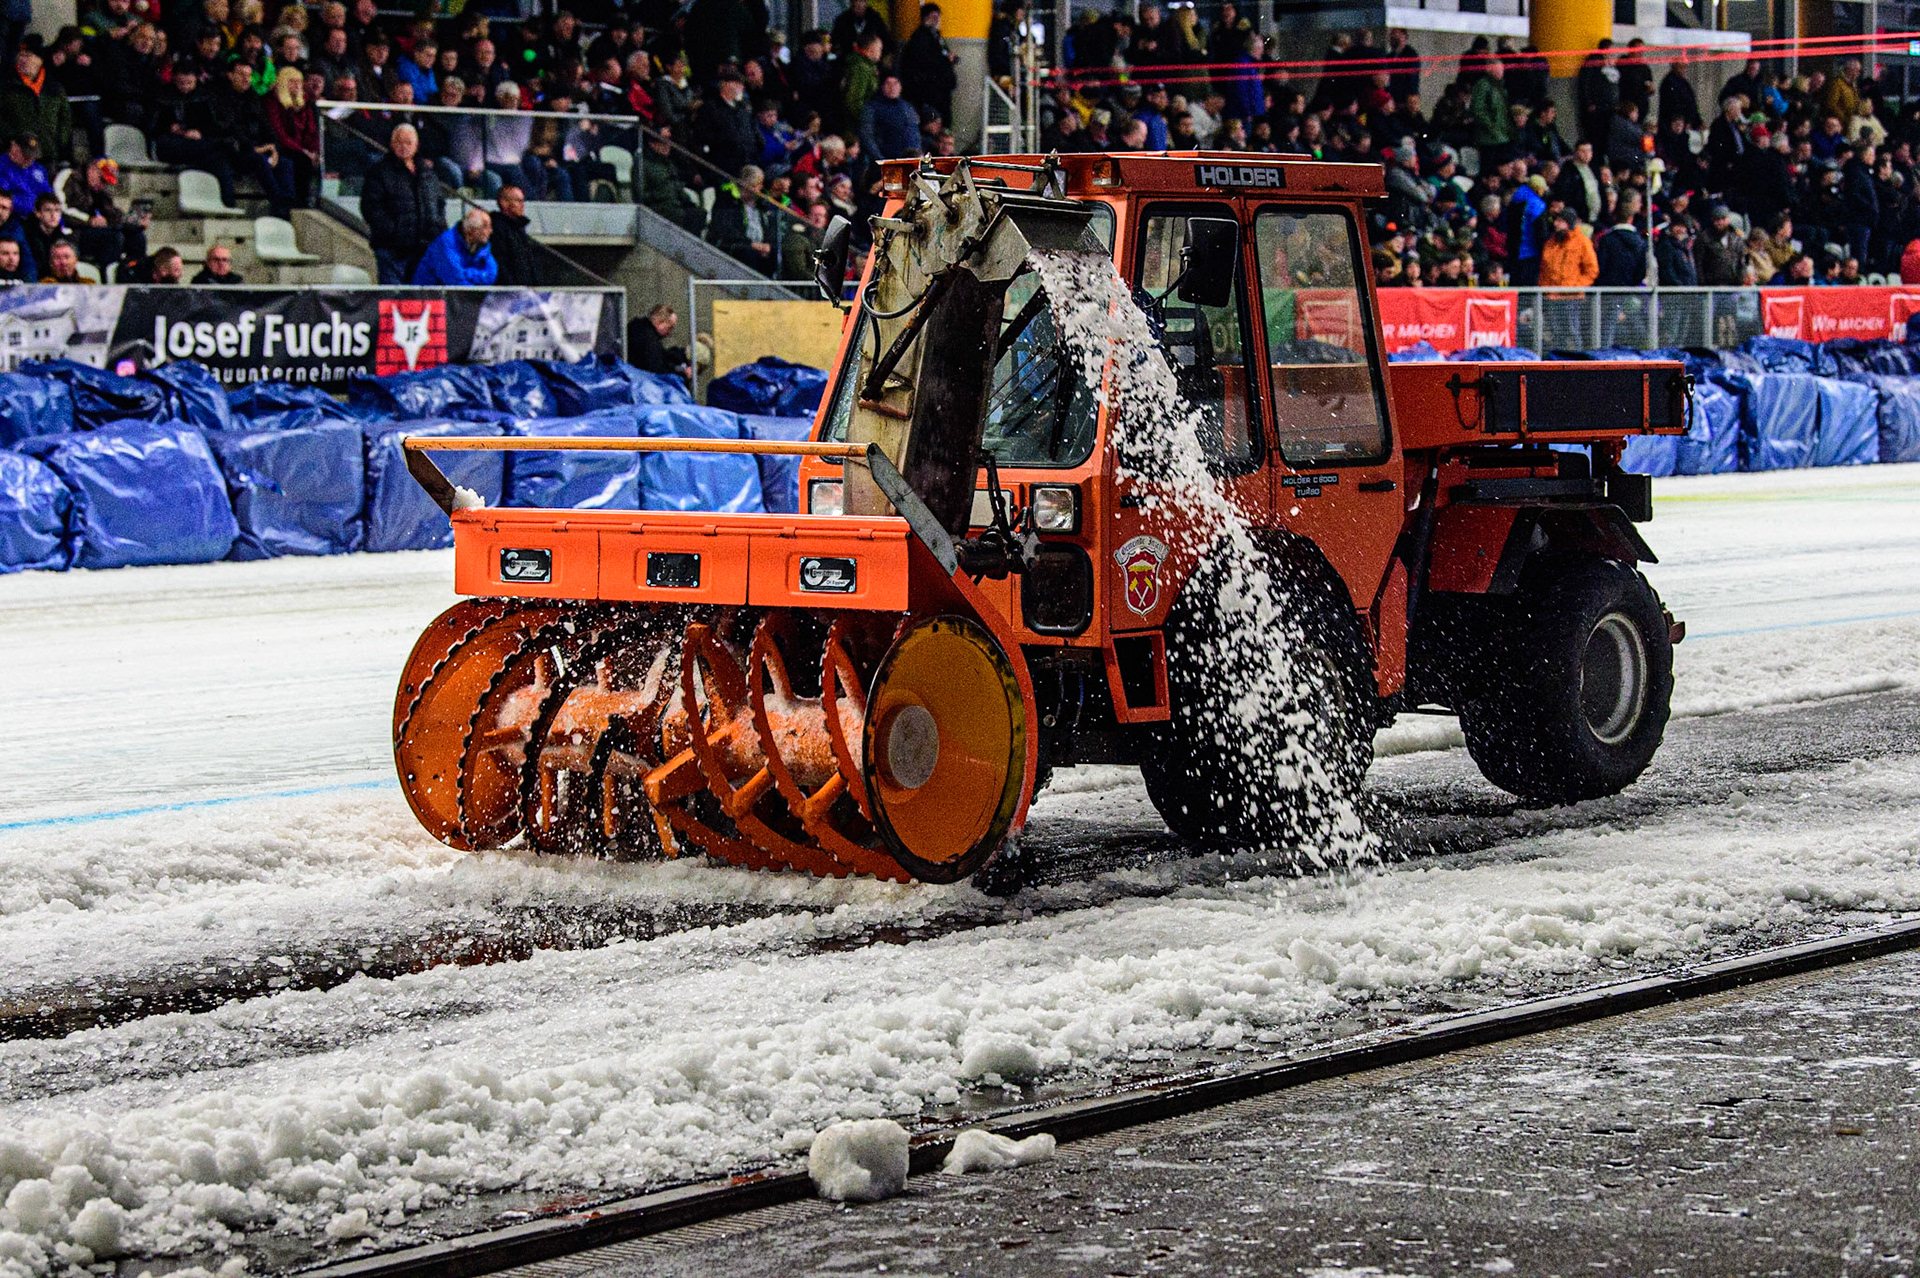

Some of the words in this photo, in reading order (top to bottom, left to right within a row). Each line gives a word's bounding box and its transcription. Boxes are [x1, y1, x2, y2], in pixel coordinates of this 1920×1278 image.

[1200, 166, 1280, 187] HOLDER
[152, 310, 256, 367] Josef
[263, 311, 371, 358] Fuchs
[1397, 322, 1459, 339] MACHEN
[1296, 488, 1320, 496] TURBO
